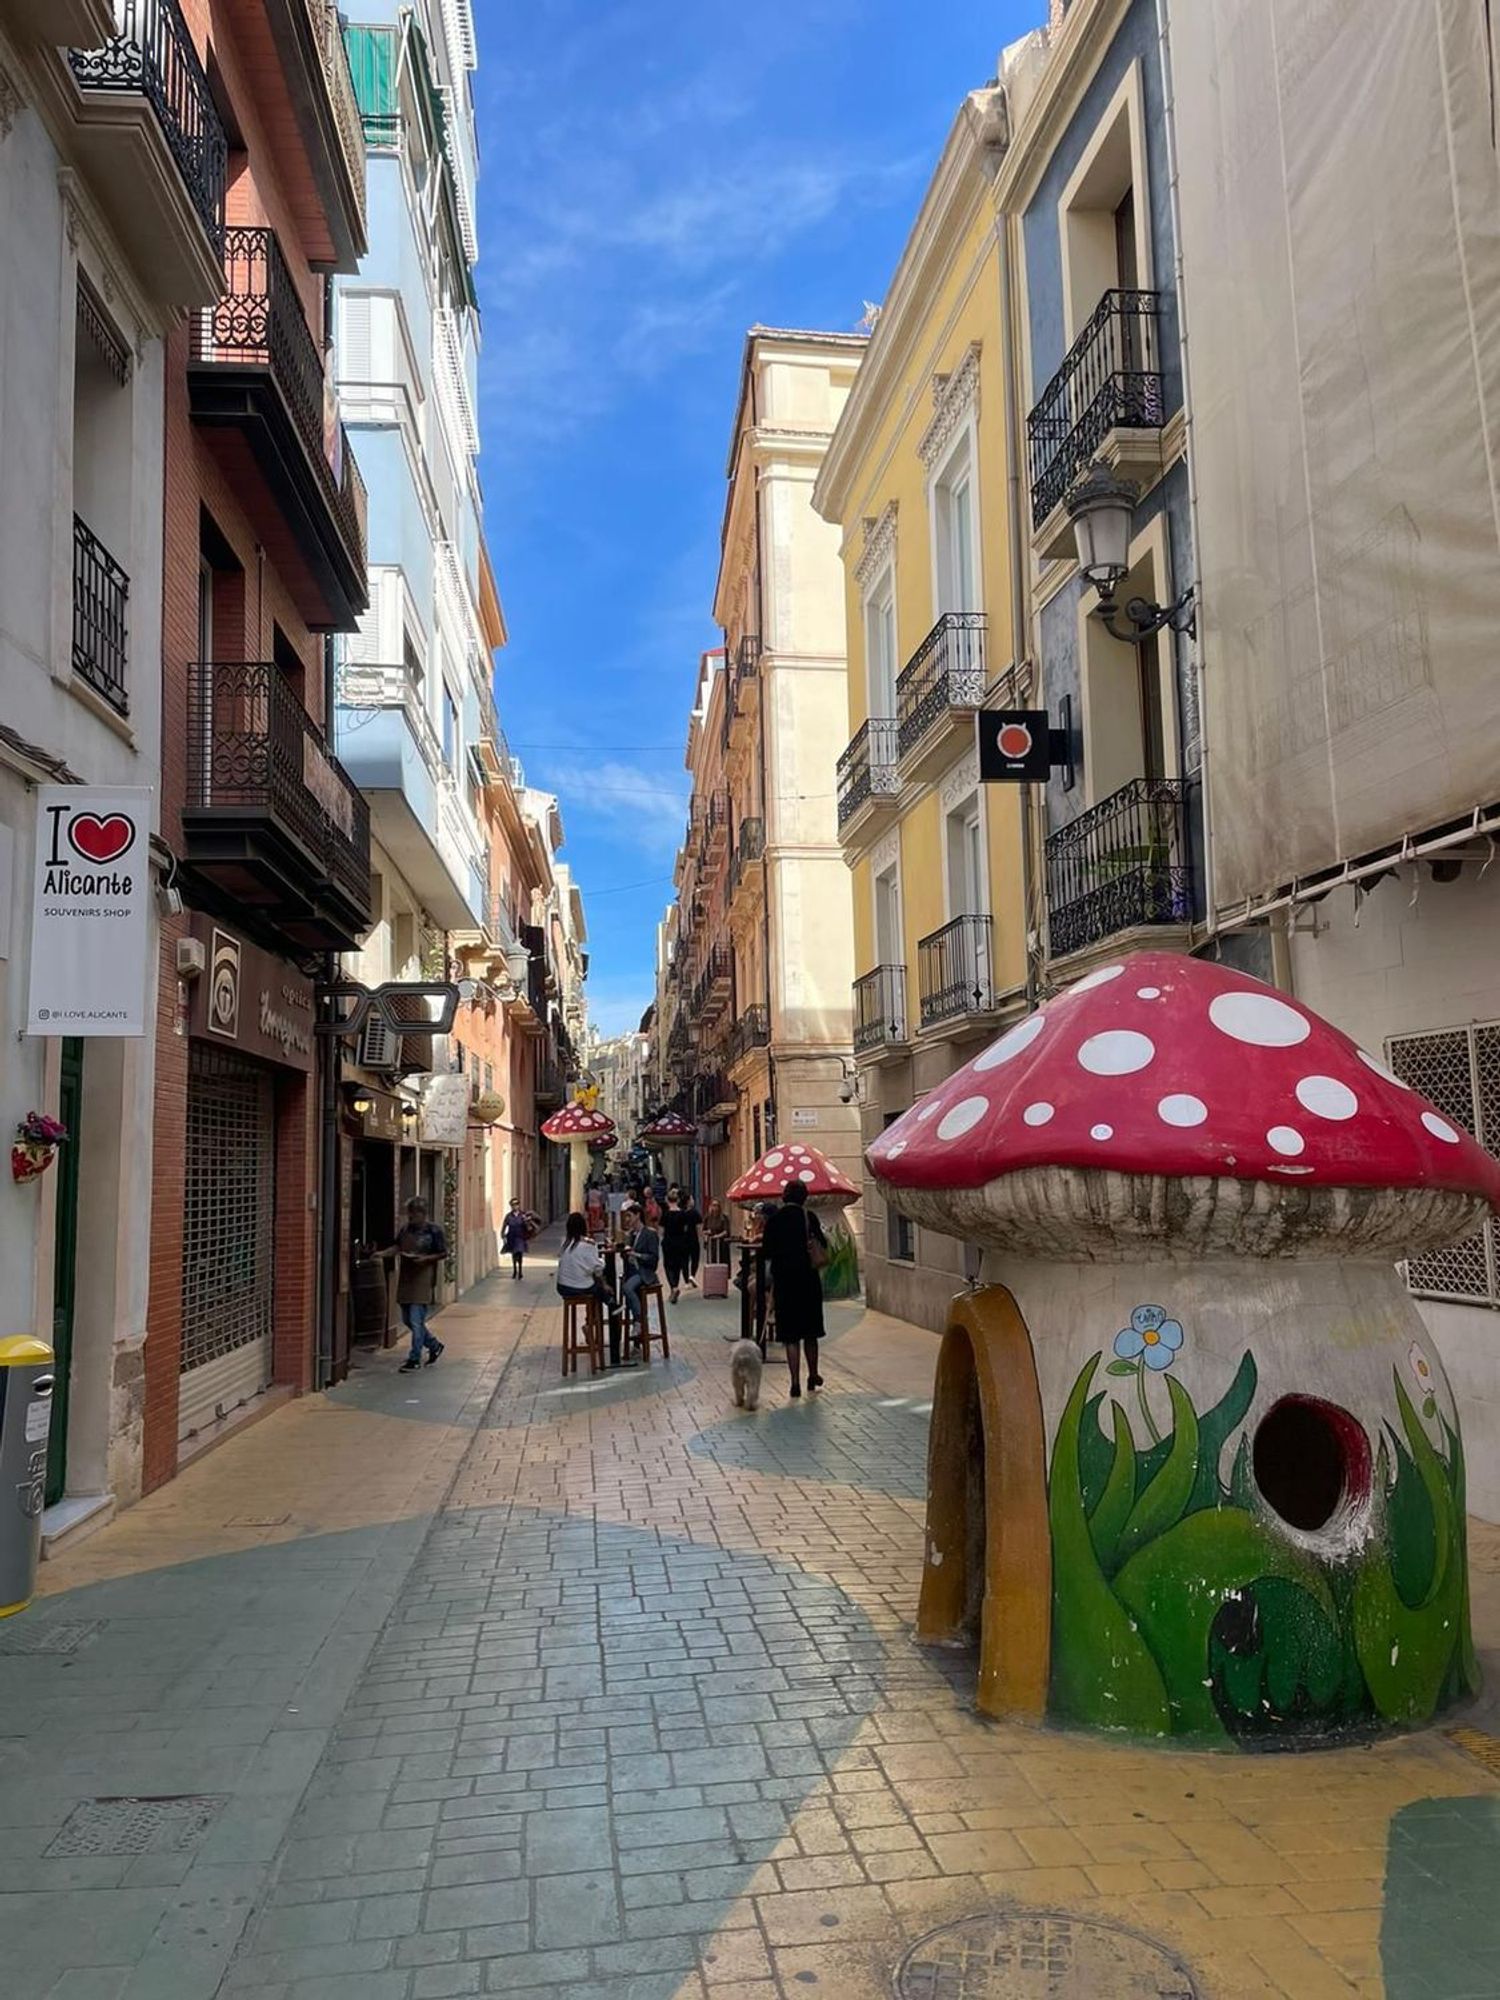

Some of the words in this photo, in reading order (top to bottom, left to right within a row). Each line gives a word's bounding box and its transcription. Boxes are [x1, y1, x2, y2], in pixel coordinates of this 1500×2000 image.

[46, 805, 71, 867] I
[43, 869, 132, 896] Alicante
[44, 907, 101, 917] SOUVENIRS
[103, 908, 131, 917] SHOP
